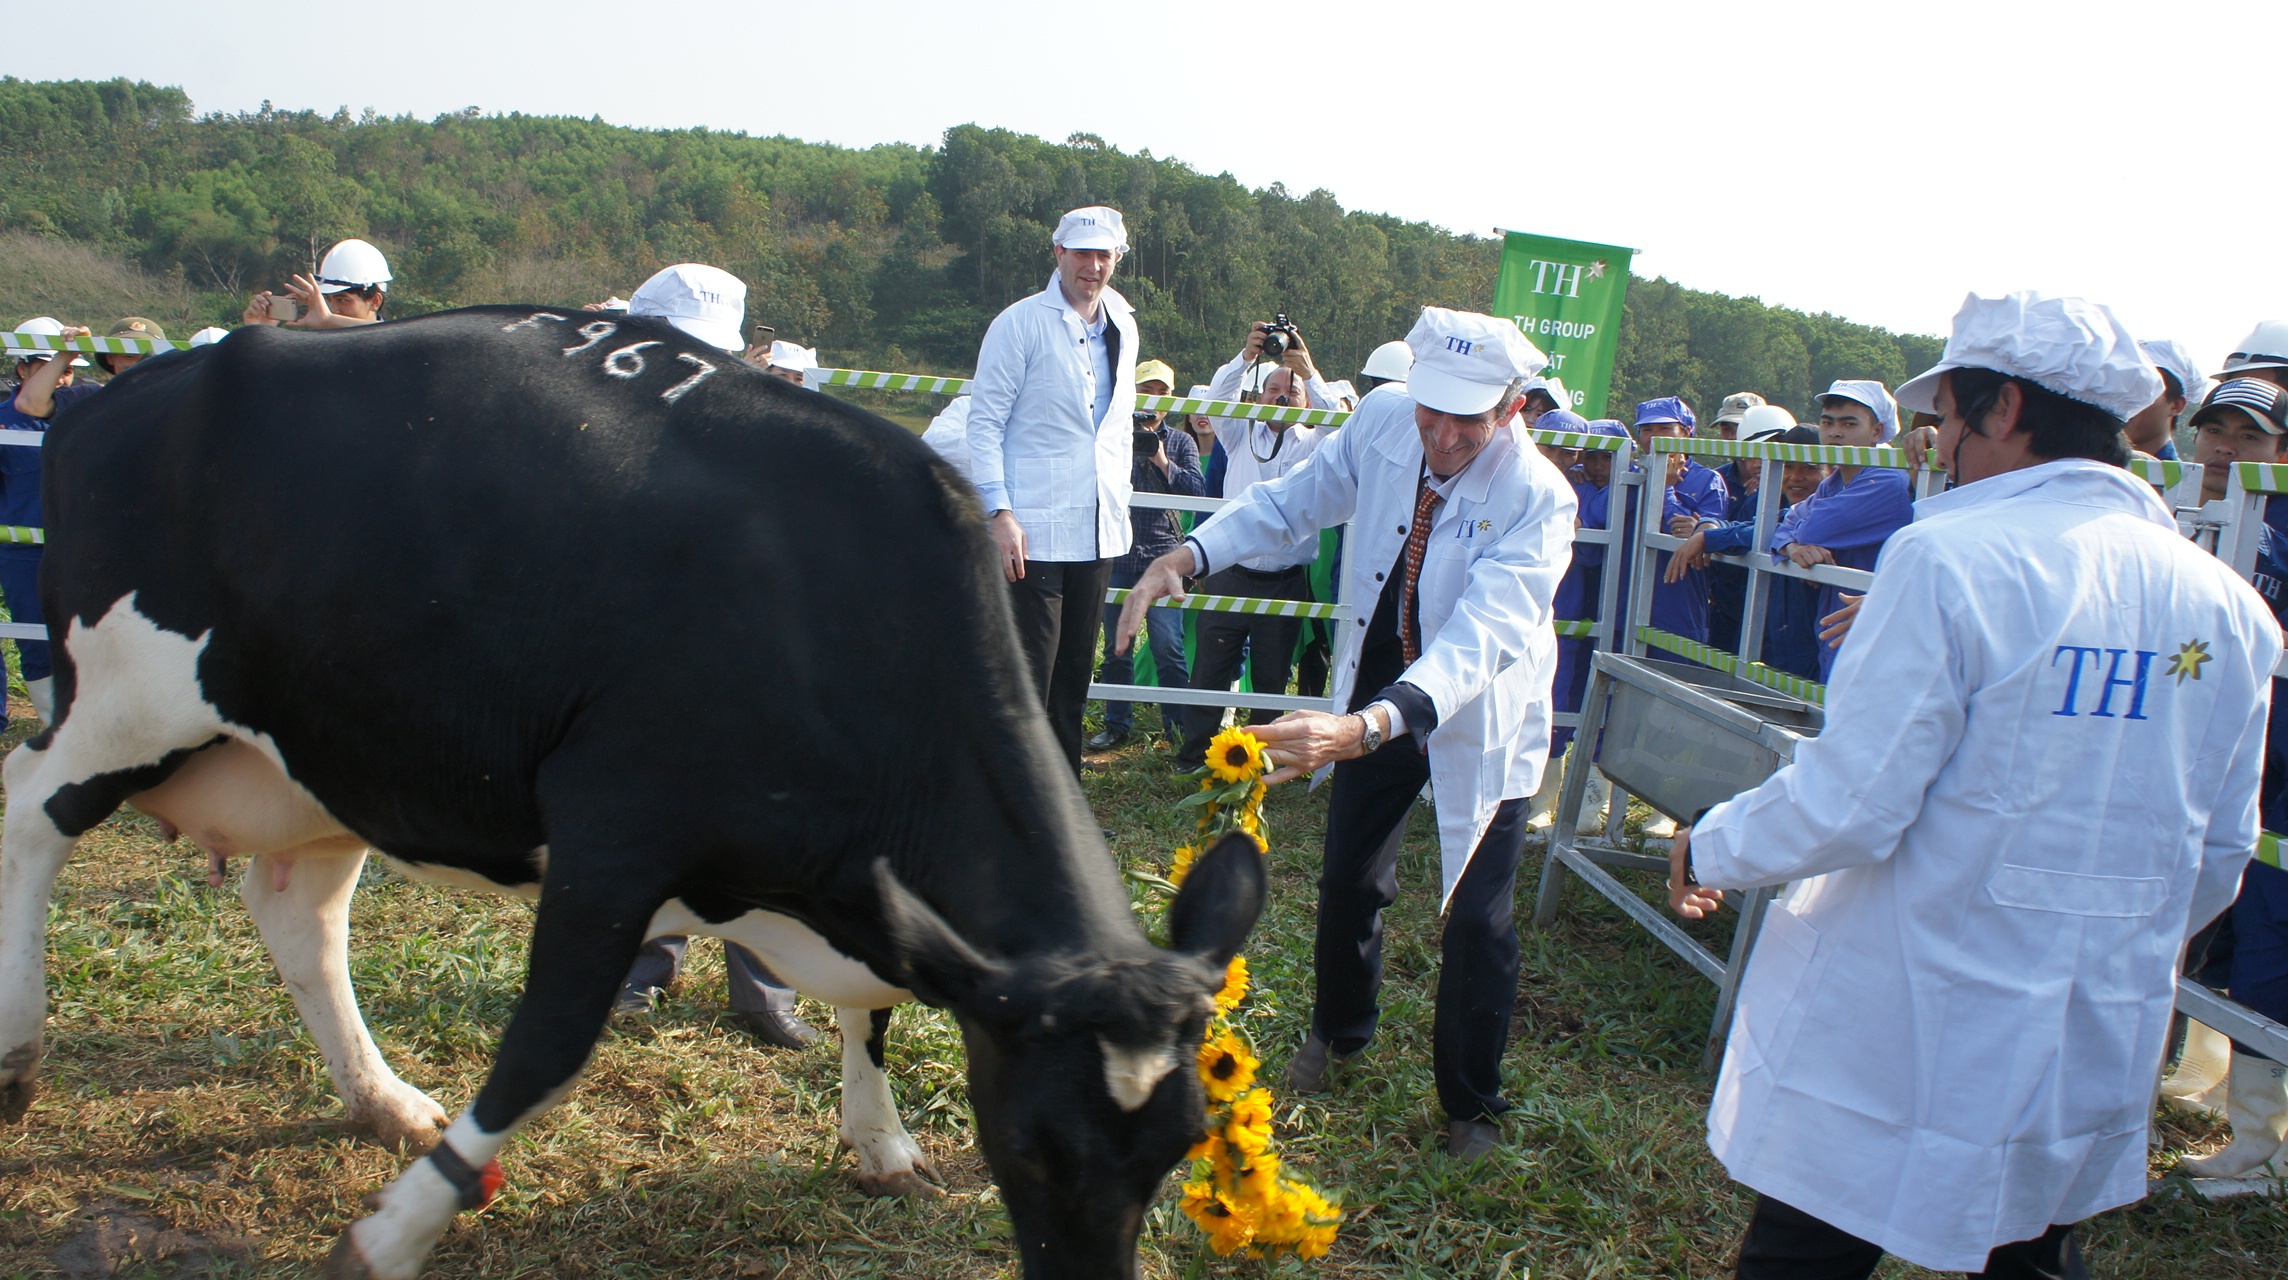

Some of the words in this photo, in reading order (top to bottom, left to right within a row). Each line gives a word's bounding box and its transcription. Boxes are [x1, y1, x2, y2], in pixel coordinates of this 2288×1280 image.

[1081, 218, 1095, 226] TH
[1529, 260, 1585, 298] TH
[700, 291, 720, 304] TH
[1514, 315, 1536, 333] TH
[1540, 319, 1595, 340] GROUP
[1446, 336, 1472, 355] TH
[2253, 572, 2283, 600] TH
[2051, 645, 2158, 720] TH
